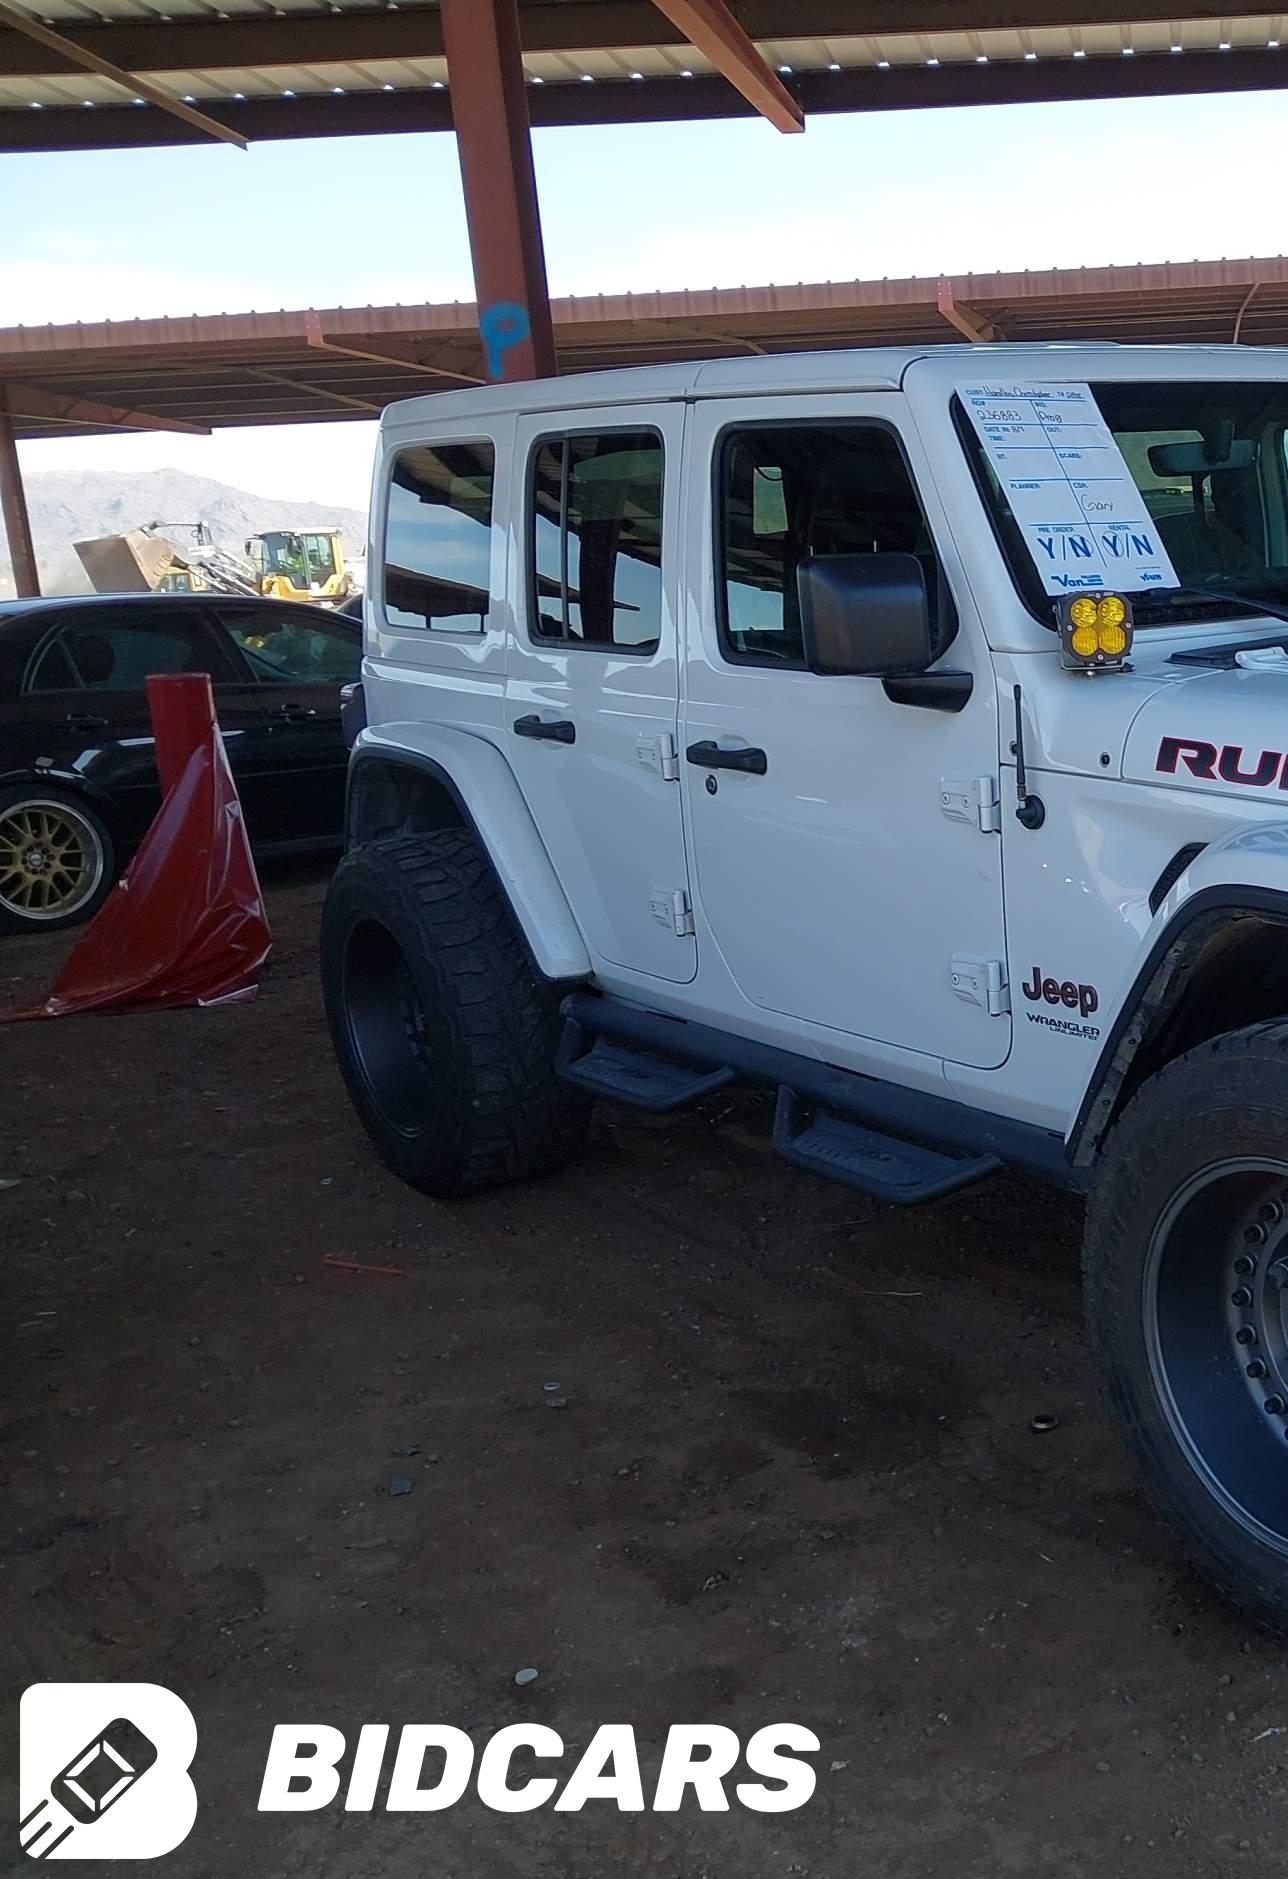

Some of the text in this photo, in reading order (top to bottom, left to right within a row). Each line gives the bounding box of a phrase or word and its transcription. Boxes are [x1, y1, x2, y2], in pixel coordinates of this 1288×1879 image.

[976, 409, 1022, 421] 236883
[1021, 966, 1099, 1019] Jeep
[1026, 1012, 1100, 1036] WRANGLER
[1049, 1025, 1099, 1041] UNLIMITED
